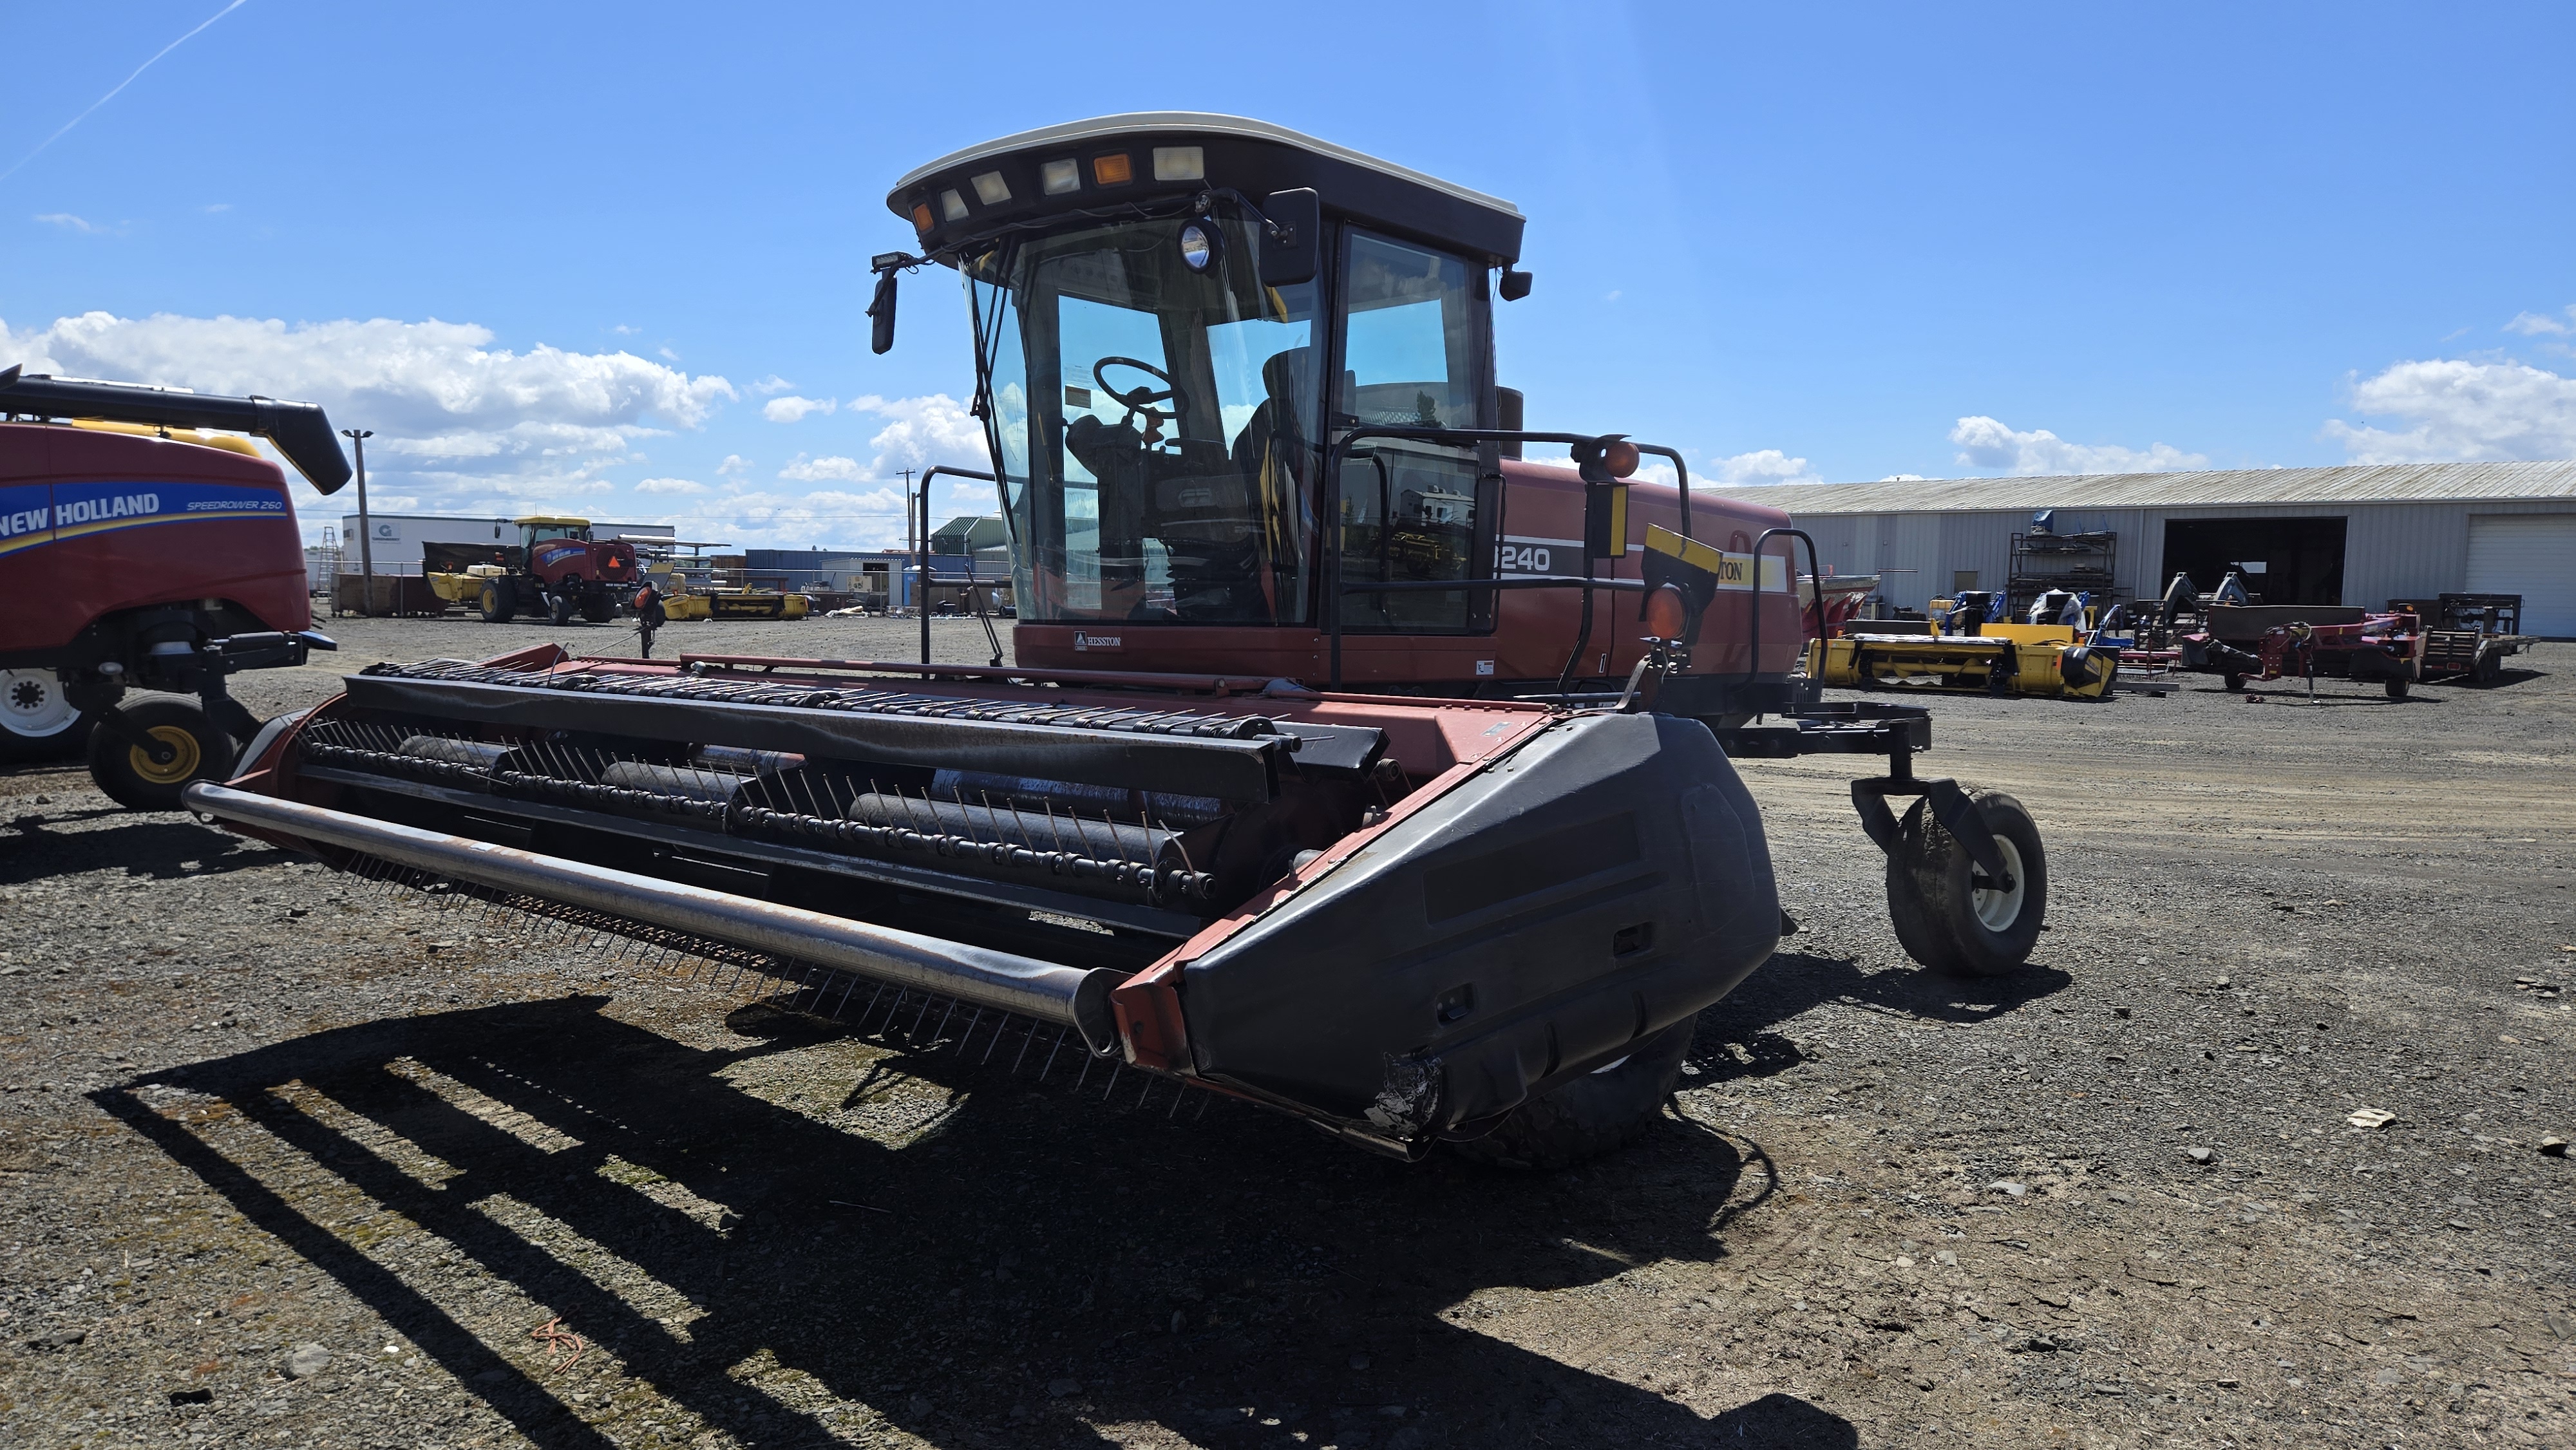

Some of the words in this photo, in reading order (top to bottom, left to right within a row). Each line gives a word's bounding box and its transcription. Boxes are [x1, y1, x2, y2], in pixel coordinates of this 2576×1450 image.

[187, 501, 259, 511] SPEEDROWER
[260, 501, 282, 509] 260
[0, 507, 49, 536] NEW
[55, 493, 160, 526] HOLLAND
[1720, 561, 1743, 581] TON
[1087, 637, 1121, 646] HESSTON
